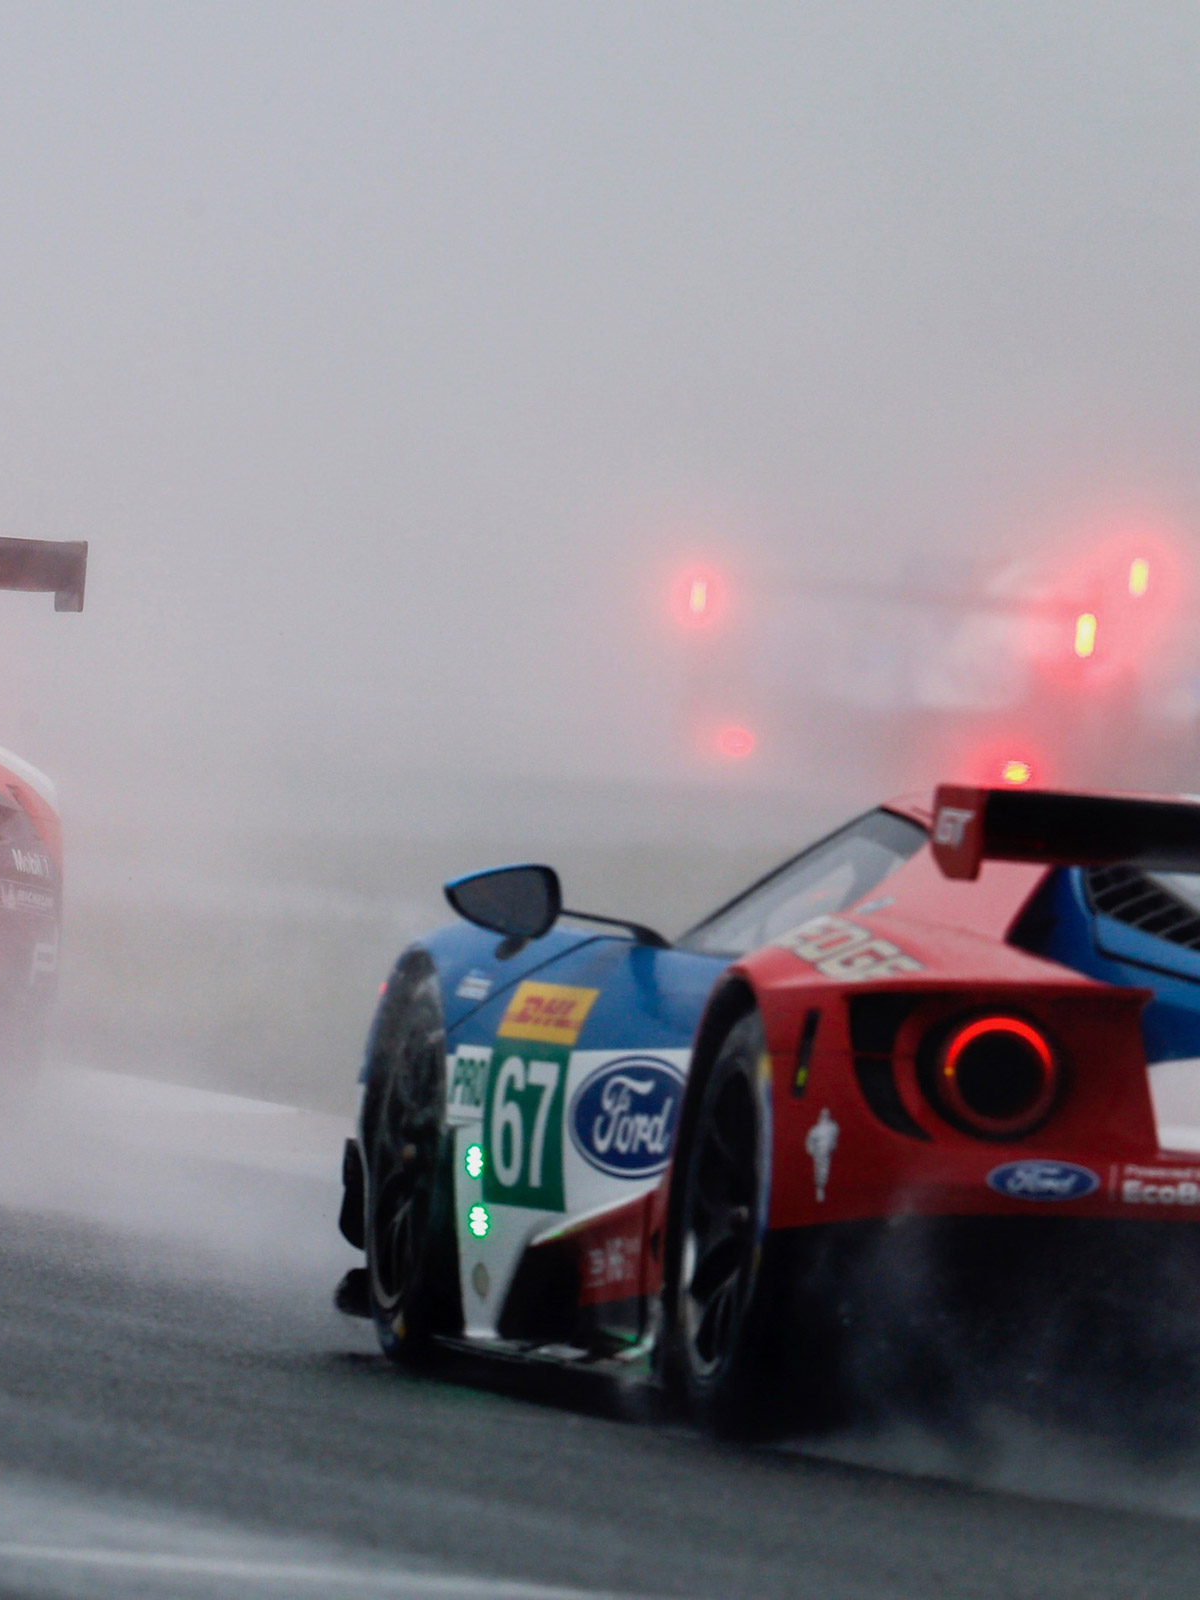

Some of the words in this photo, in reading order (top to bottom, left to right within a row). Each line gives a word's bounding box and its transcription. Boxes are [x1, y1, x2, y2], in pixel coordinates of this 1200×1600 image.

[452, 1057, 488, 1107] PRO
[592, 1074, 673, 1155] Ford
[491, 1055, 560, 1189] 67
[1005, 1161, 1080, 1195] Ford
